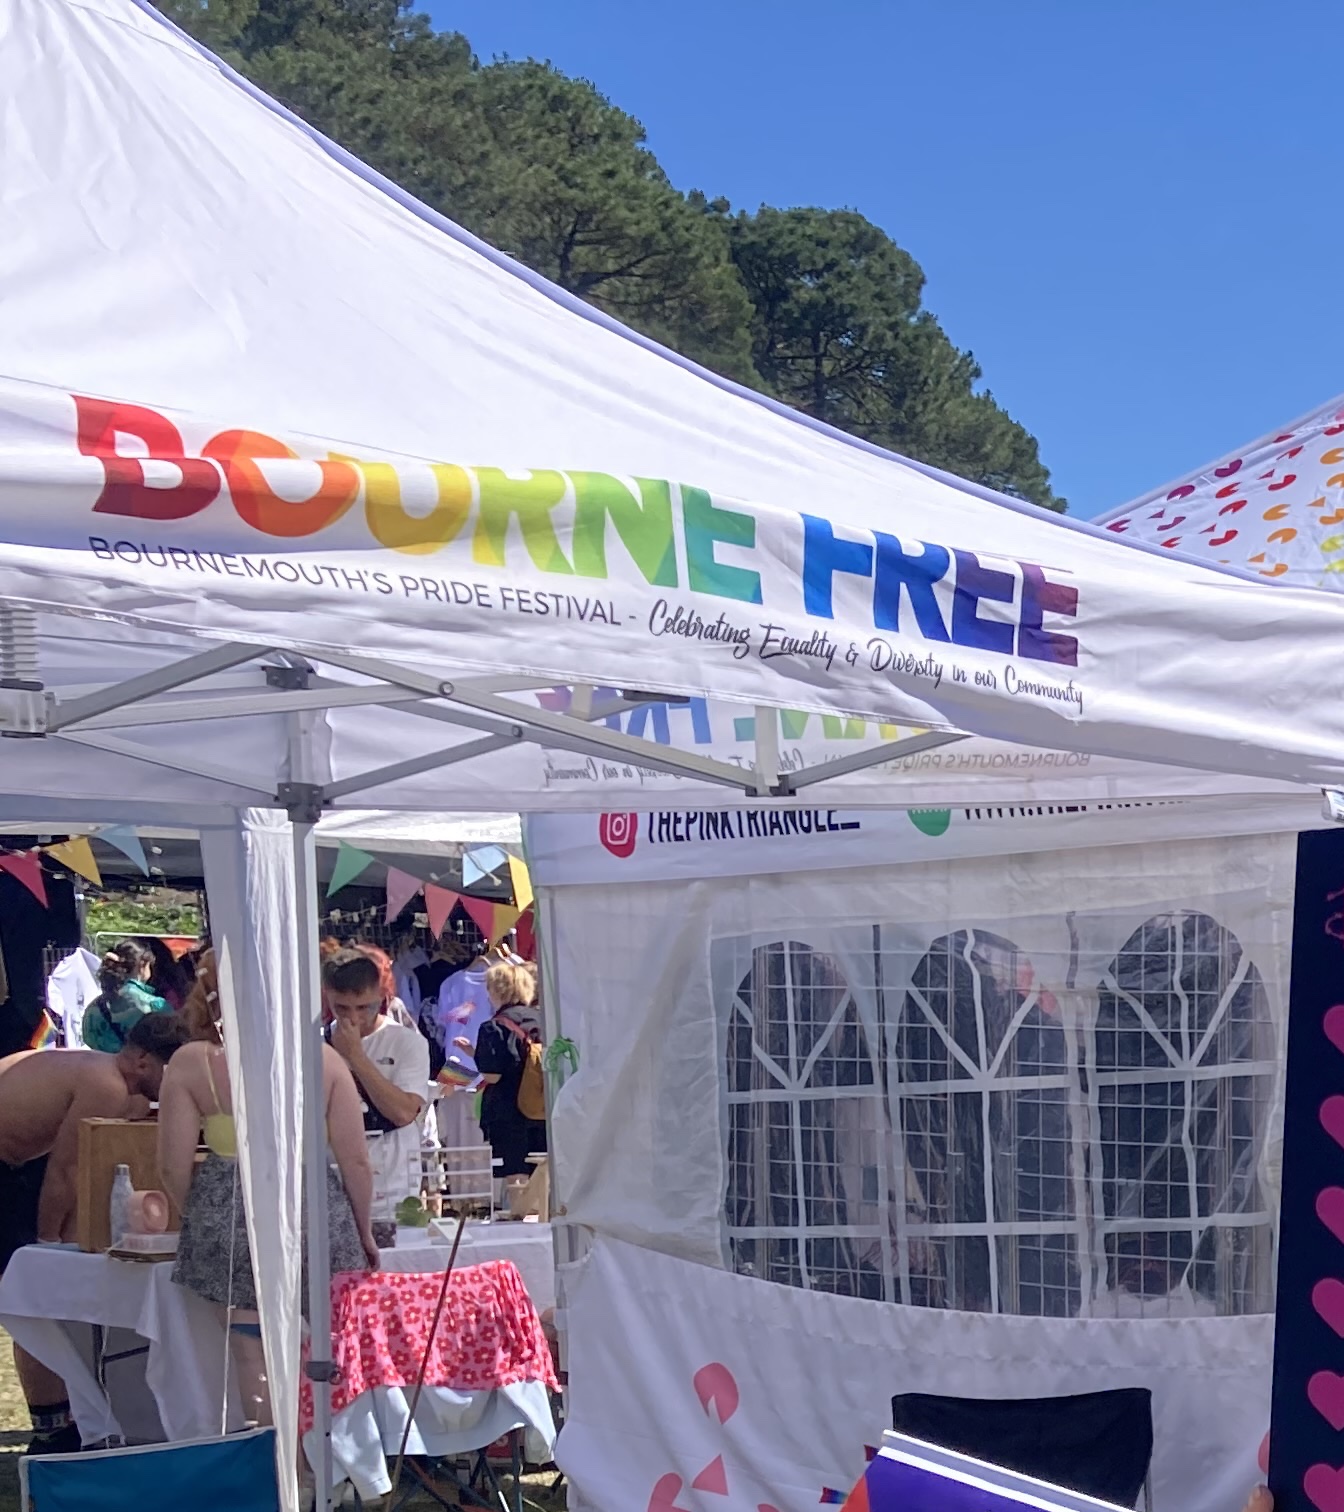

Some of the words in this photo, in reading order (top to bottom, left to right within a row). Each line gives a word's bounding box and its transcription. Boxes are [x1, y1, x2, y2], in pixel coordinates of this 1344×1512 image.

[71, 394, 763, 605] BOURNE
[800, 512, 1079, 667] FREE
[88, 536, 393, 594] BOURNEMOUTH'S
[399, 575, 493, 608] PRIDE
[499, 586, 622, 625] FESTIVAL
[649, 598, 750, 659] Celebrating
[759, 623, 838, 671] Equality
[845, 642, 859, 667] &
[867, 638, 943, 689] Diversity
[952, 664, 967, 683] in
[974, 669, 997, 690] our
[1004, 664, 1083, 714] Community
